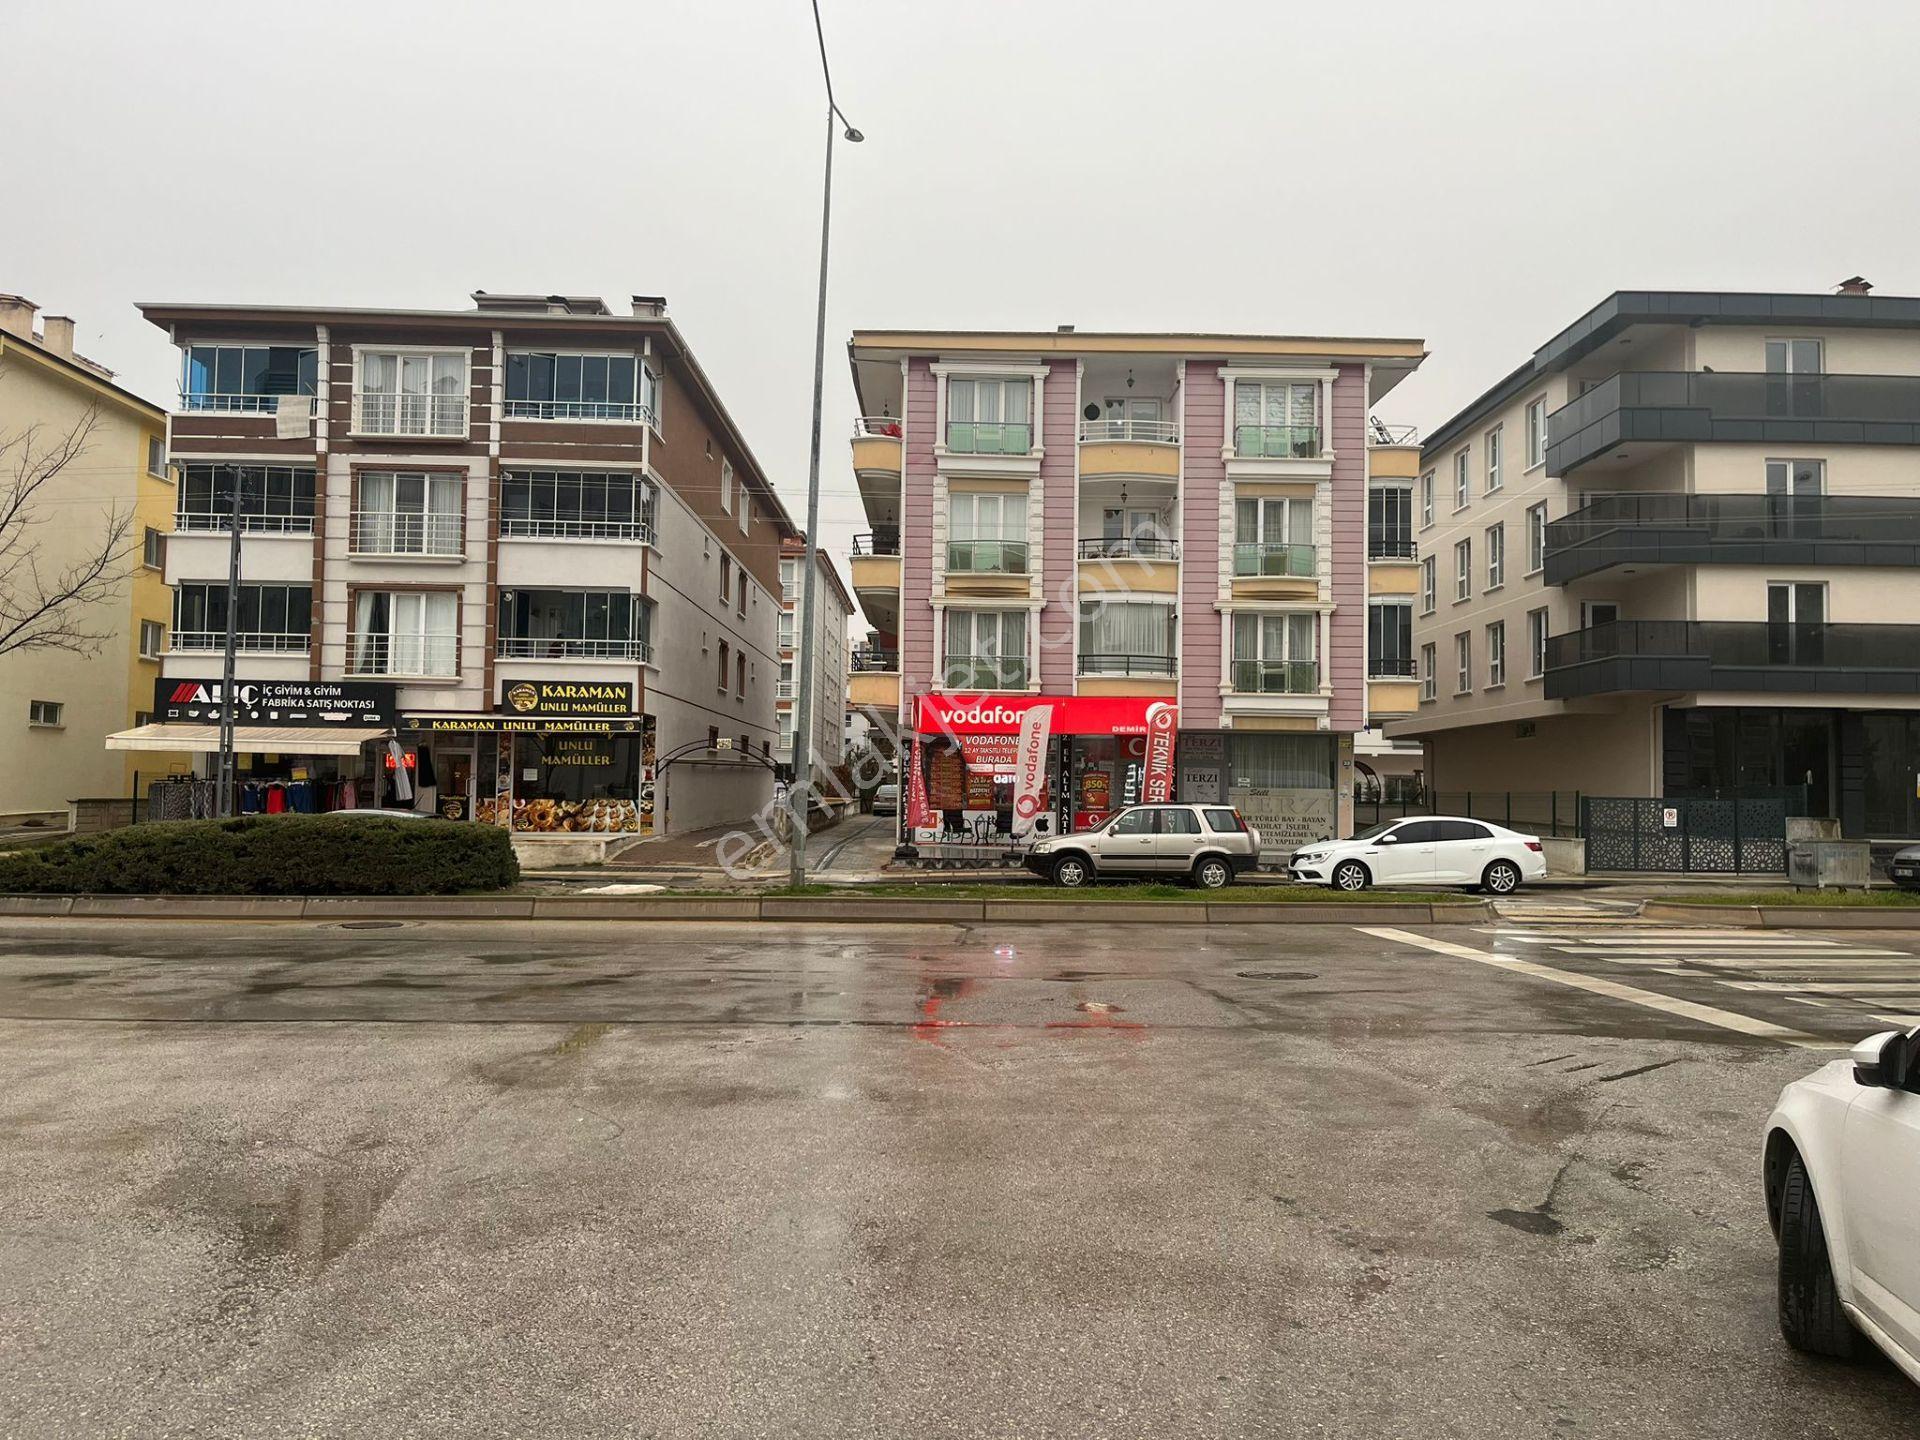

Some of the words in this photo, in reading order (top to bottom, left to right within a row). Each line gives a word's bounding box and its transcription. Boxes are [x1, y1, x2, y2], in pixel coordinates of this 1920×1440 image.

[262, 684, 273, 697] İÇ
[275, 684, 303, 696] GİYİM
[304, 687, 312, 696] &
[314, 685, 342, 696] GİYİM
[542, 685, 626, 699] KARAMAN
[262, 697, 305, 708] FABRİKA
[306, 699, 332, 710] SATIŞ
[333, 700, 375, 709] NOKTASI
[540, 702, 569, 712] UNLU
[572, 702, 627, 713] MAMÜLLER
[940, 706, 1024, 724] vodafon
[432, 721, 495, 730] KARAMAN
[503, 722, 536, 731] UNLU
[545, 720, 611, 732] MAMÜLLER
[559, 740, 593, 751] UNLU
[965, 736, 1020, 746] VODAFONE
[541, 752, 610, 766] MAMÜLLER
[1024, 721, 1042, 790] vodafone
[1150, 731, 1171, 776] TEKNİK
[1148, 779, 1166, 803] SER
[1061, 806, 1069, 835] SATI
[1301, 816, 1326, 824] BAYAN
